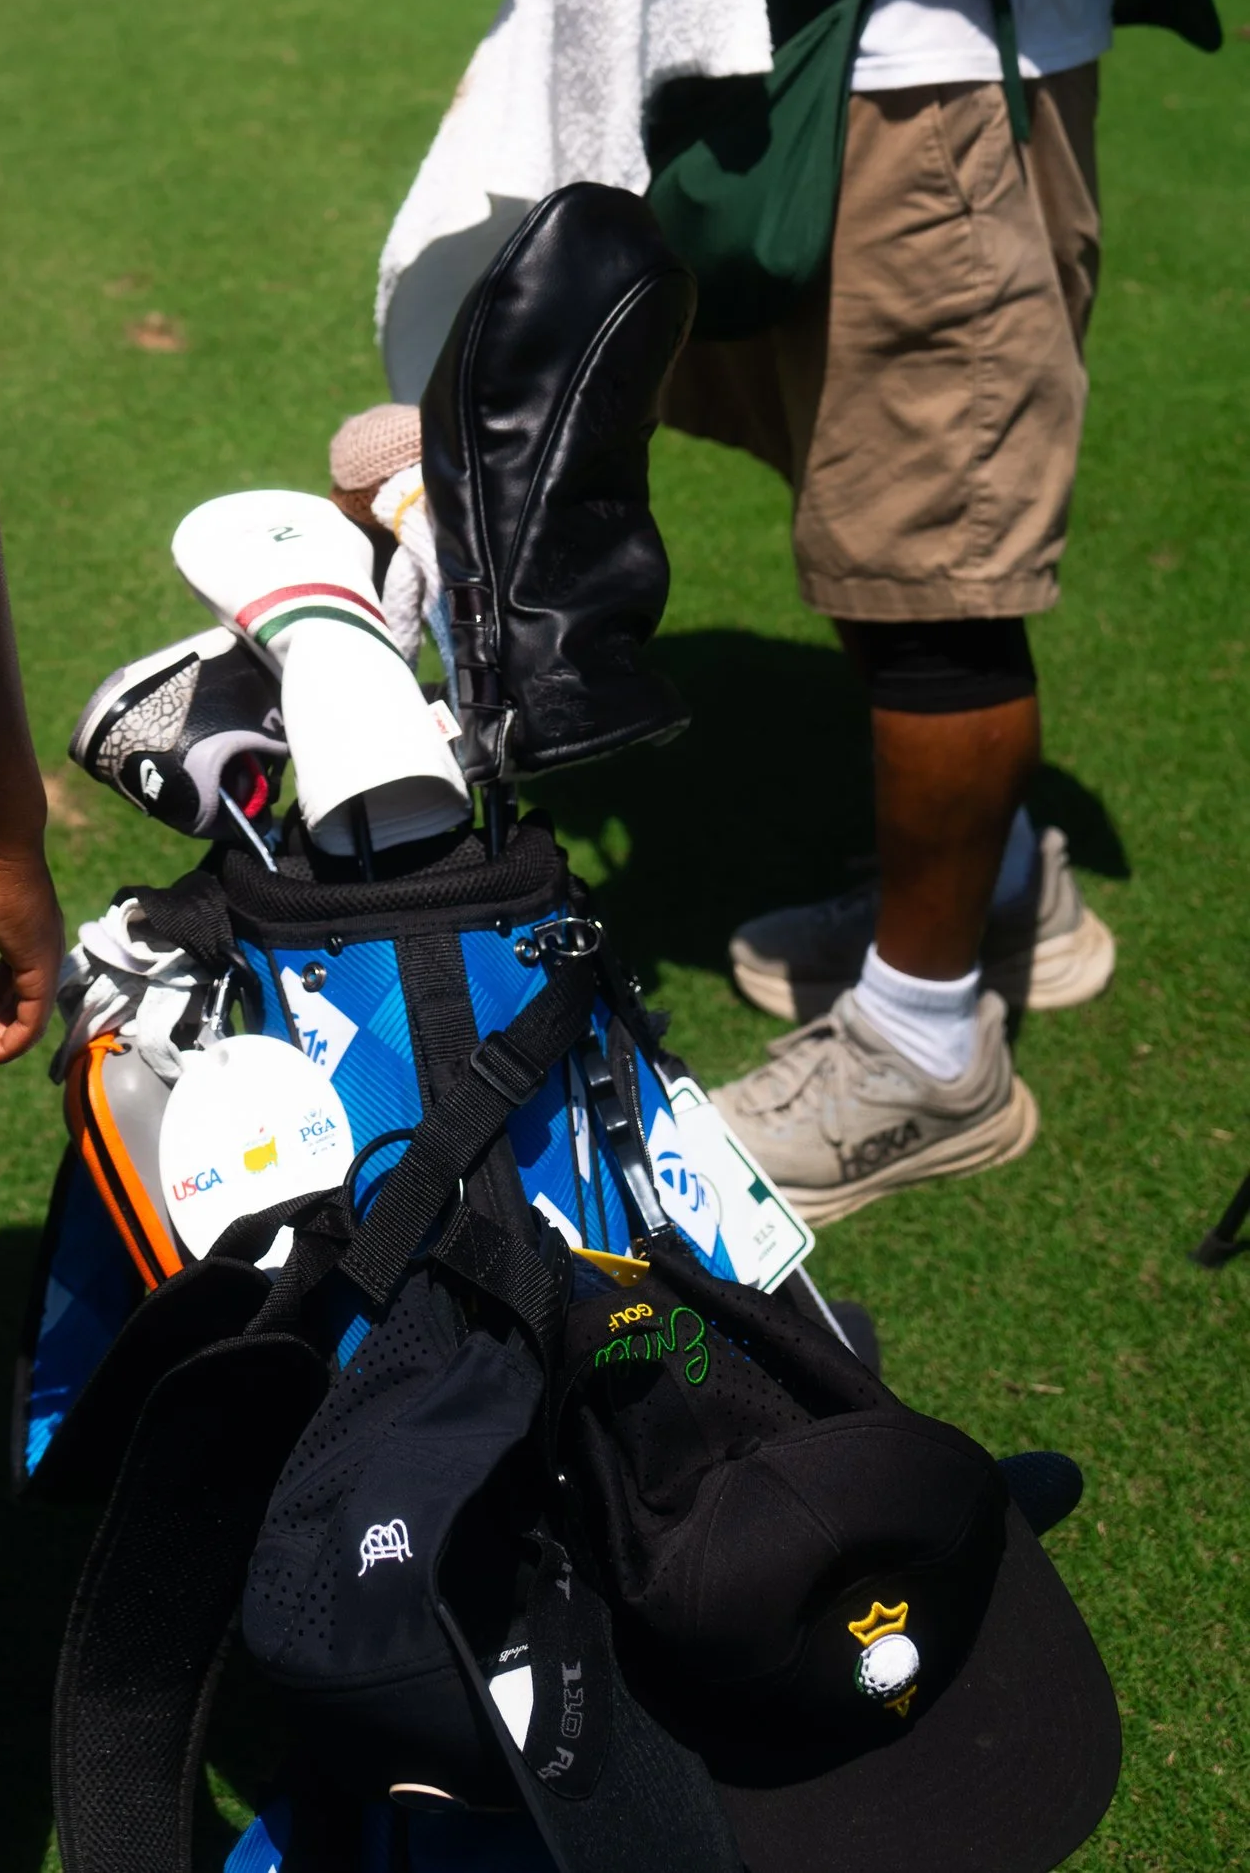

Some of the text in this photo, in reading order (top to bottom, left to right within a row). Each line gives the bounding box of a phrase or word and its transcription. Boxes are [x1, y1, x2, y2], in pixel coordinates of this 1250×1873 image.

[299, 1117, 338, 1142] PGA
[840, 1118, 922, 1183] HOKA
[172, 1167, 224, 1202] USGA
[608, 1303, 654, 1333] GOLF
